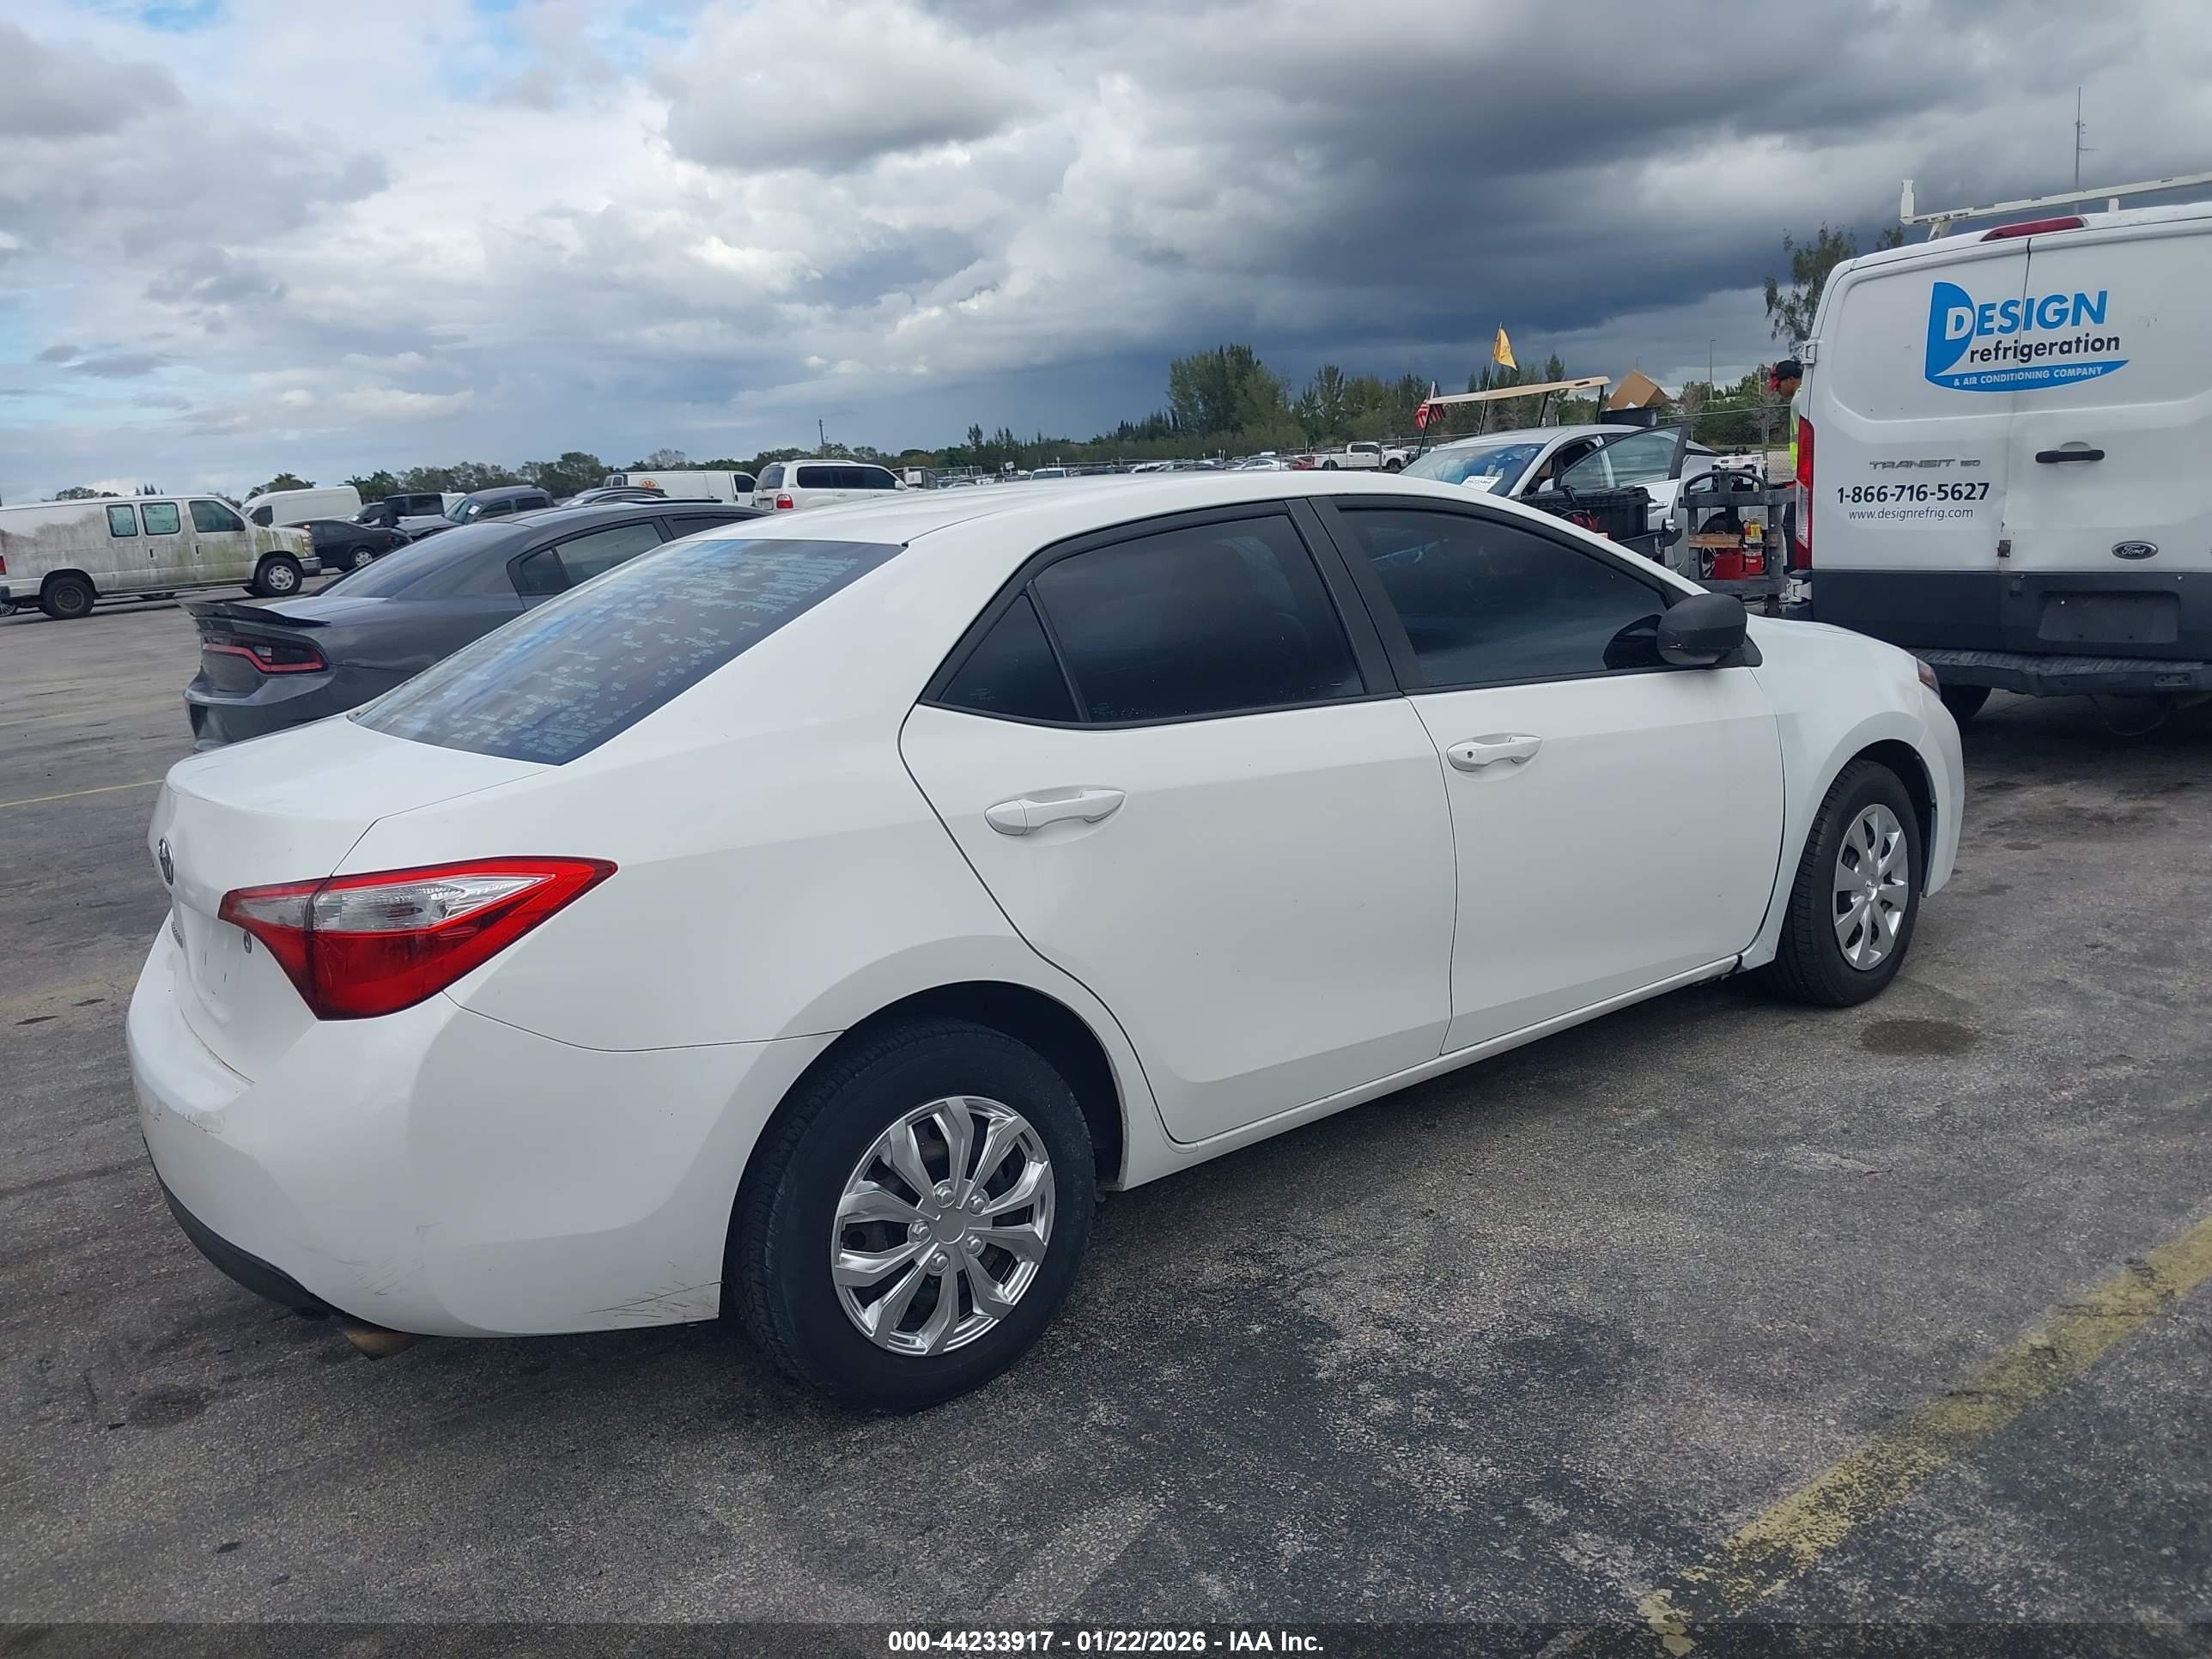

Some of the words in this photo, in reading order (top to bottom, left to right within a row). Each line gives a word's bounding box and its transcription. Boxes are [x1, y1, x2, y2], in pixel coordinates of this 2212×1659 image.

[1945, 289, 2108, 341] DESIGN
[1969, 331, 2121, 364] refrigeration
[1954, 377, 1960, 386] &
[1963, 374, 1978, 386] AIR
[1980, 369, 2050, 384] CONDITIONING
[2053, 365, 2104, 379] COMPANY
[1869, 459, 1956, 470] TRANSIT
[1837, 483, 1990, 503] 1-866-716-5627
[1849, 507, 1972, 522] www.designrefrig.com
